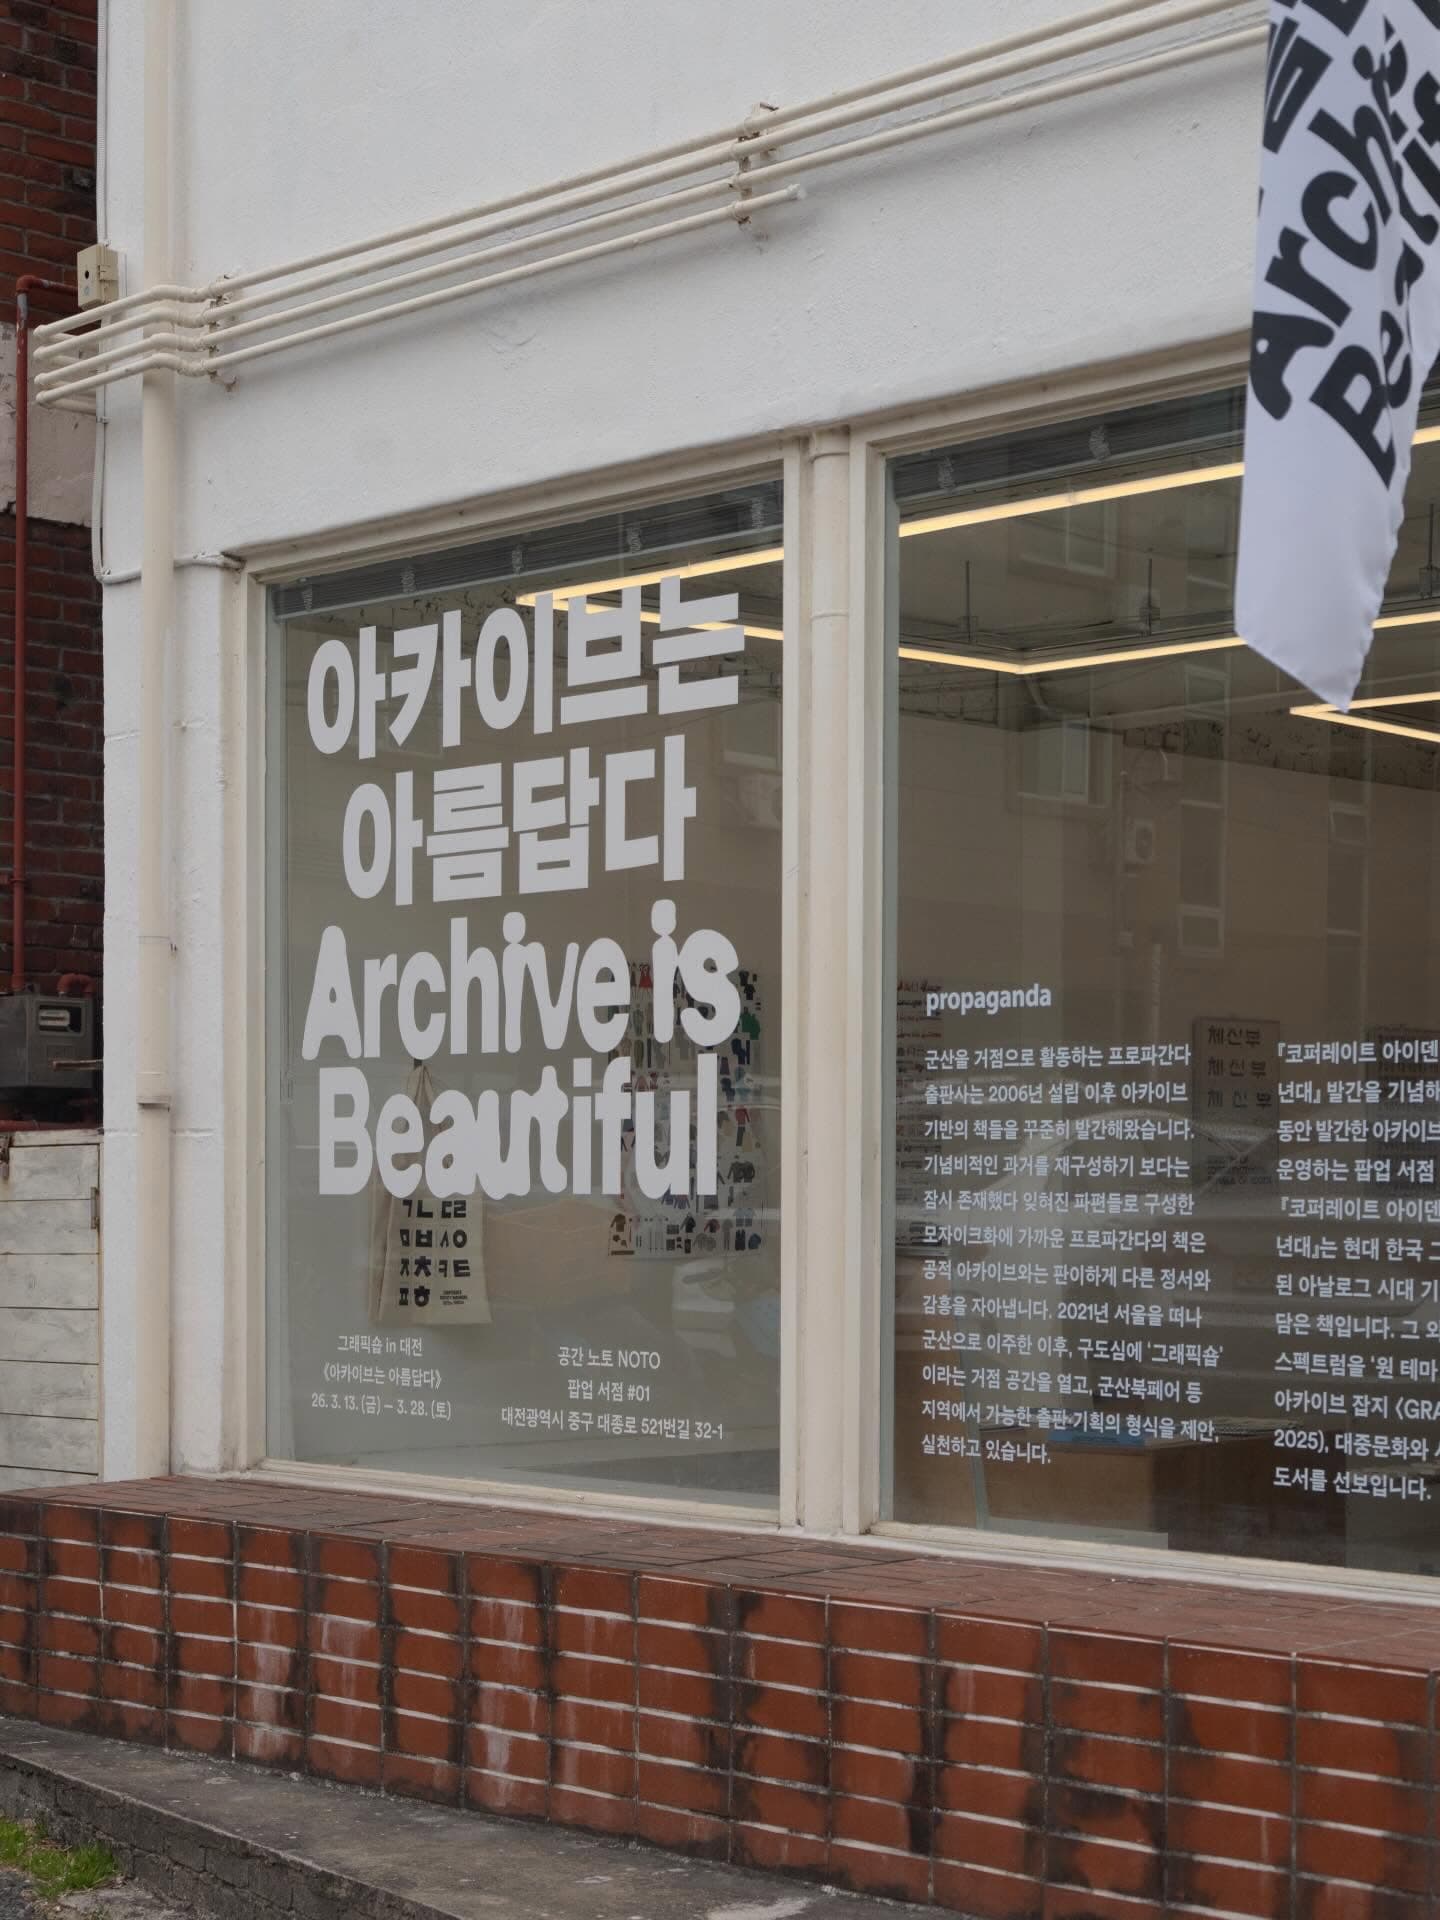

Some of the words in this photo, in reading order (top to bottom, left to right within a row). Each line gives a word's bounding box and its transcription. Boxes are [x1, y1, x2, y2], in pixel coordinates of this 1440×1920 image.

[307, 574, 745, 760] 아카이브는
[342, 734, 697, 905] 아름답다
[302, 911, 630, 1061] Archive
[651, 899, 741, 1046] is
[926, 983, 1052, 1016] propaganda
[924, 1050, 970, 1070] 군산을
[974, 1048, 1034, 1069] 거점으로
[1039, 1046, 1103, 1068] 활동하는
[1107, 1044, 1191, 1066] 프로파간다
[924, 1084, 984, 1104] 출판사는
[988, 1084, 1044, 1104] 2006년
[1048, 1082, 1079, 1103] 설립
[1085, 1082, 1116, 1103] 이후
[1121, 1081, 1188, 1102] 아카이브
[1327, 1080, 1382, 1103] 발간을
[319, 1053, 718, 1200] Beautiful
[924, 1119, 969, 1140] 기반의
[973, 1119, 1019, 1140] 책들을
[1023, 1120, 1070, 1140] 꾸준히
[1075, 1119, 1195, 1141] 발간해왔습니다.
[1277, 1120, 1312, 1142] 동안
[1316, 1120, 1369, 1142] 발간한
[924, 1155, 998, 1176] 기념비적인
[1003, 1155, 1049, 1177] 과거를
[1054, 1156, 1134, 1178] 재구성하기
[1139, 1156, 1190, 1178] 보다는
[1276, 1158, 1349, 1182] 운영하는
[1354, 1159, 1391, 1183] 팝업
[1397, 1160, 1434, 1183] 서점
[924, 1189, 952, 1211] 잠시
[957, 1190, 1018, 1212] 존재했다
[1023, 1191, 1069, 1213] 잊혀진
[1074, 1192, 1139, 1215] 파편들로
[1144, 1193, 1195, 1215] 구성한
[923, 1225, 1013, 1247] 모자이크화에
[1018, 1227, 1065, 1248] 가까운
[1069, 1229, 1167, 1252] 프로파간다의
[1172, 1231, 1207, 1253] 책은
[1343, 1237, 1379, 1261] 현대
[1386, 1238, 1423, 1263] 한국
[923, 1260, 951, 1281] 공적
[957, 1261, 1049, 1284] 아카이브와는
[1053, 1264, 1117, 1287] 판이하게
[1122, 1267, 1155, 1288] 다른
[1160, 1269, 1211, 1291] 정서와
[1275, 1273, 1293, 1296] 된
[1299, 1274, 1372, 1298] 아날로그
[1377, 1277, 1414, 1301] 시대
[971, 1296, 1052, 1320] 자아냅니다.
[1057, 1302, 1109, 1323] 2021년
[1114, 1304, 1164, 1327] 서울을
[1169, 1307, 1203, 1328] 떠나
[1275, 1312, 1311, 1336] 담은
[1316, 1314, 1395, 1340] 책입니다.
[1401, 1320, 1420, 1339] 그
[337, 1335, 382, 1355] 그래픽숍
[386, 1337, 396, 1353] in
[400, 1337, 423, 1357] 대전
[558, 1346, 584, 1367] 공간
[587, 1349, 614, 1368] 노토
[618, 1351, 661, 1369] NOTO
[923, 1329, 982, 1351] 군산으로
[987, 1332, 1032, 1355] 이주한
[1037, 1335, 1073, 1358] 이후,
[1077, 1339, 1142, 1361] 구도심에
[1274, 1352, 1366, 1378] 스펙트럼을
[1400, 1357, 1438, 1382] 테마
[567, 1379, 593, 1400] 팝업
[598, 1381, 623, 1402] 서점
[627, 1384, 650, 1402] #01
[923, 1364, 966, 1386] 이라는
[971, 1367, 1000, 1389] 거점
[1005, 1370, 1052, 1392] 공간을
[1057, 1373, 1093, 1396] 열고,
[1097, 1376, 1181, 1402] 군산북페어
[1185, 1382, 1203, 1404] 등
[1275, 1389, 1347, 1415] 아카이브
[1352, 1393, 1388, 1419] 잡지
[501, 1406, 564, 1431] 대전광역시
[567, 1411, 594, 1433] 중구
[597, 1413, 638, 1435] 대종로
[641, 1418, 690, 1441] 521번길
[694, 1421, 723, 1440] 32-1
[922, 1399, 981, 1422] 지역에서
[986, 1404, 1031, 1426] 가능한
[1126, 1414, 1175, 1439] 형식을
[1181, 1418, 1219, 1443] 제안,
[922, 1434, 981, 1457] 실천하고
[986, 1439, 1052, 1464] 있습니다.
[1274, 1429, 1329, 1454] 2025),
[1335, 1432, 1429, 1462] 대중문화와
[1273, 1466, 1328, 1492] 도서를
[1333, 1471, 1432, 1501] 선보입니다.
